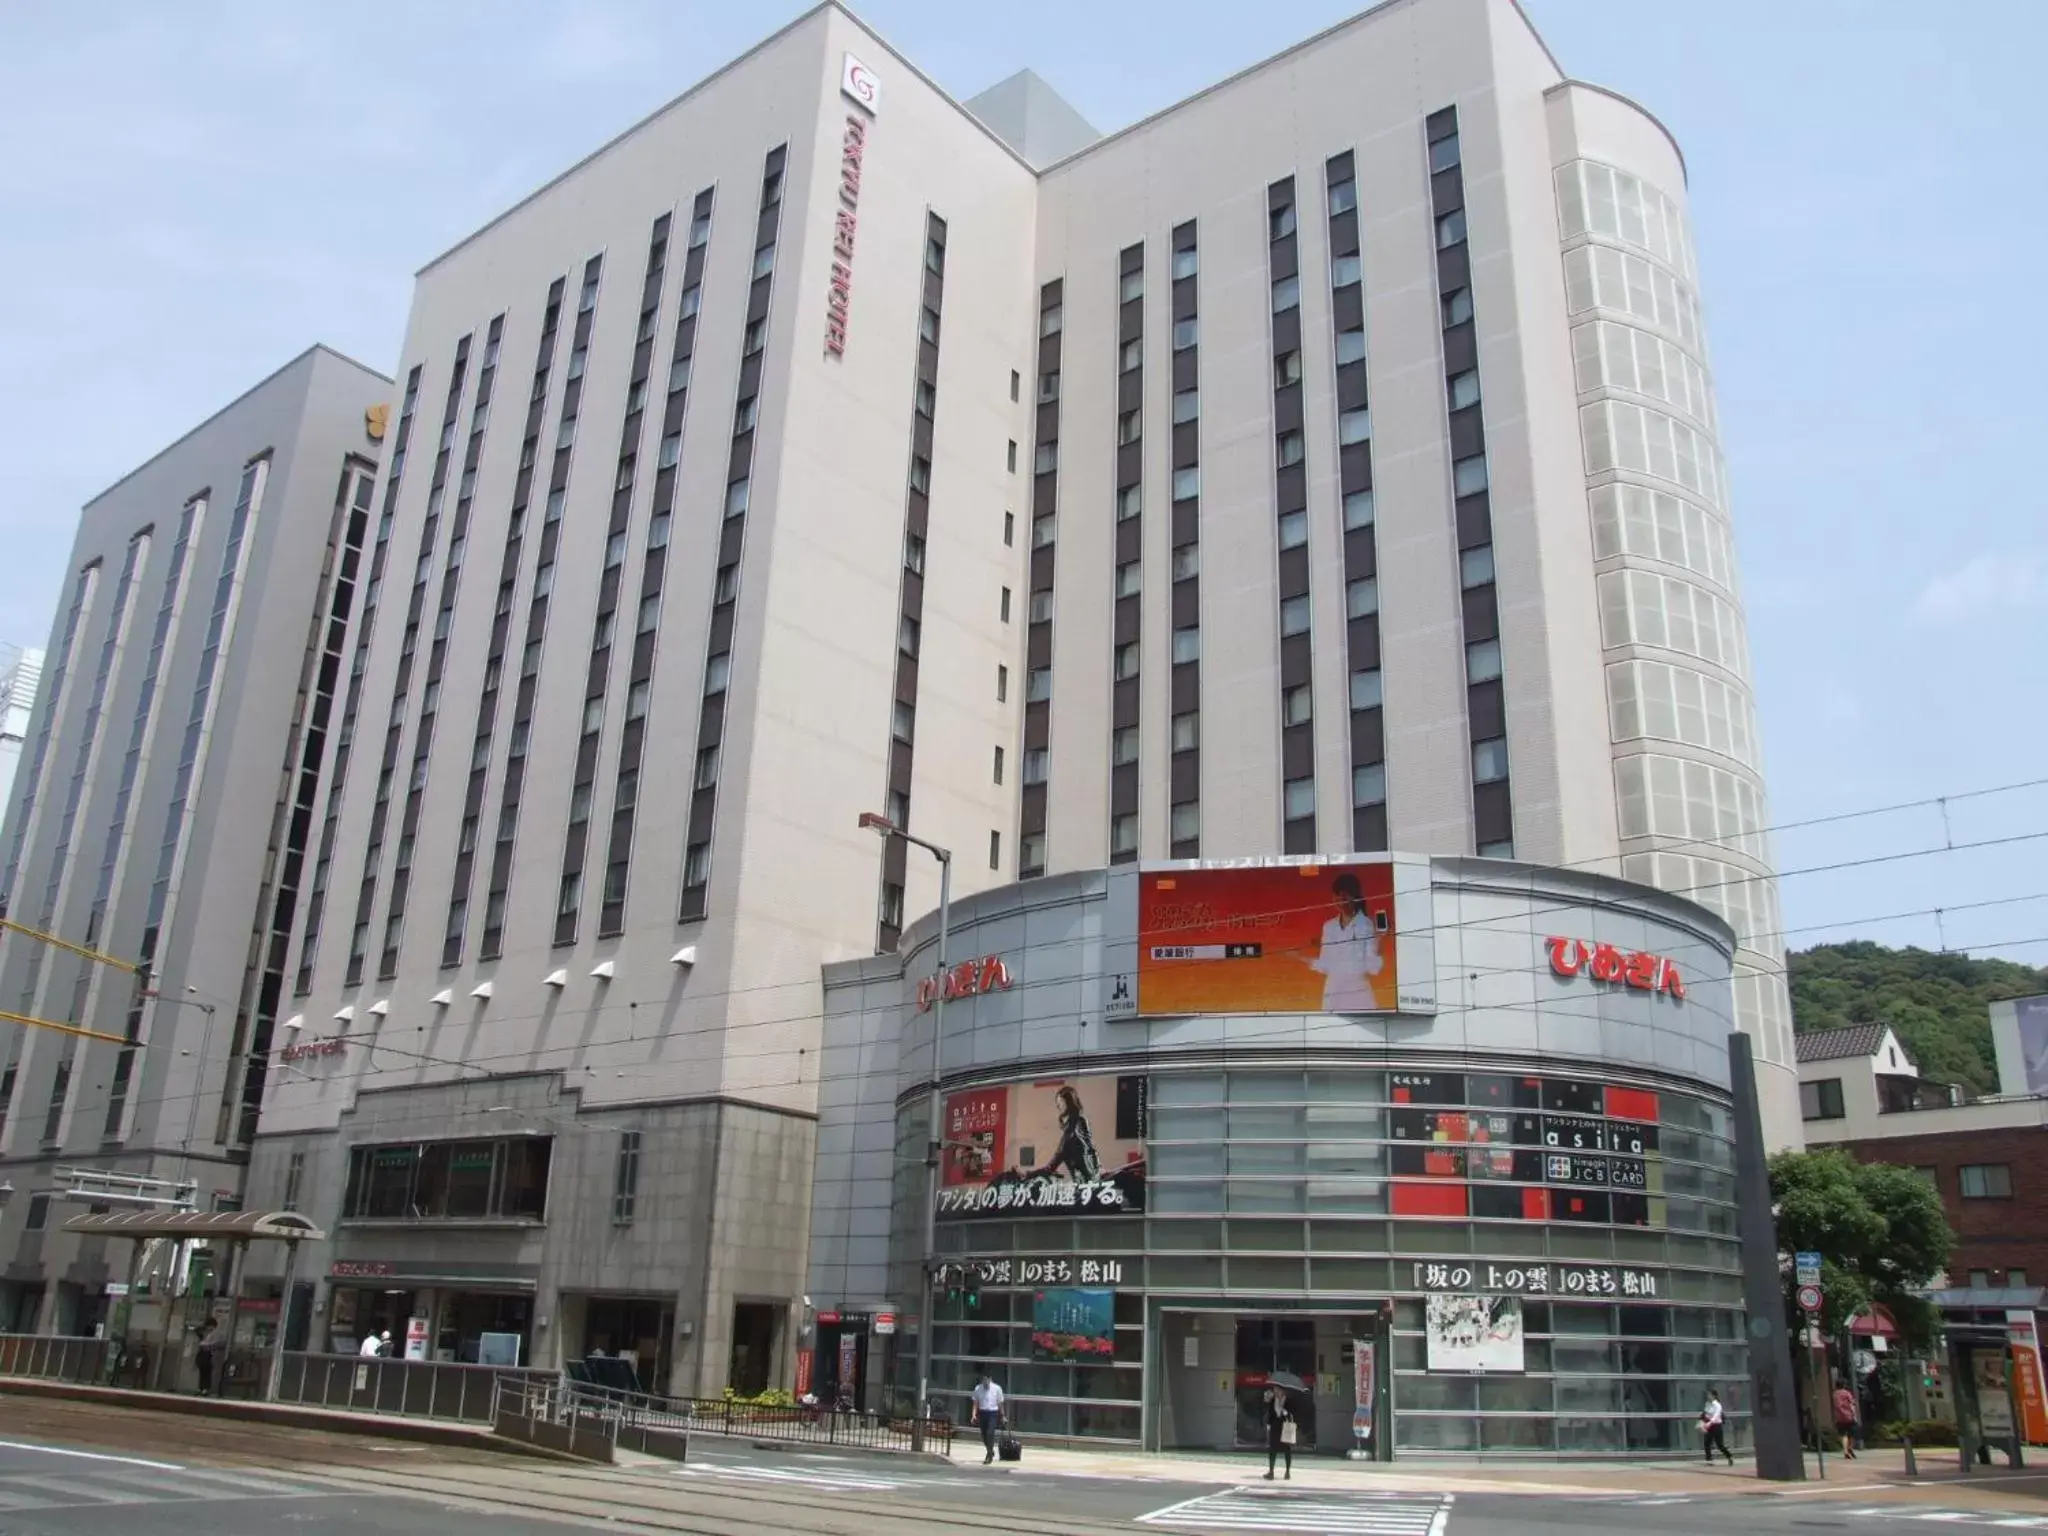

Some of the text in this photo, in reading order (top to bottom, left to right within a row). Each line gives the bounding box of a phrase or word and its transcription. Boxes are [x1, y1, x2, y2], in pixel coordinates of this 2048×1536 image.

[1544, 937, 1686, 1000] ひめぎん
[1546, 1130, 1641, 1153] asita
[1574, 1167, 1644, 1185] JCB CARD
[1080, 1260, 1121, 1283] 松山
[1622, 1269, 1656, 1296] 松山
